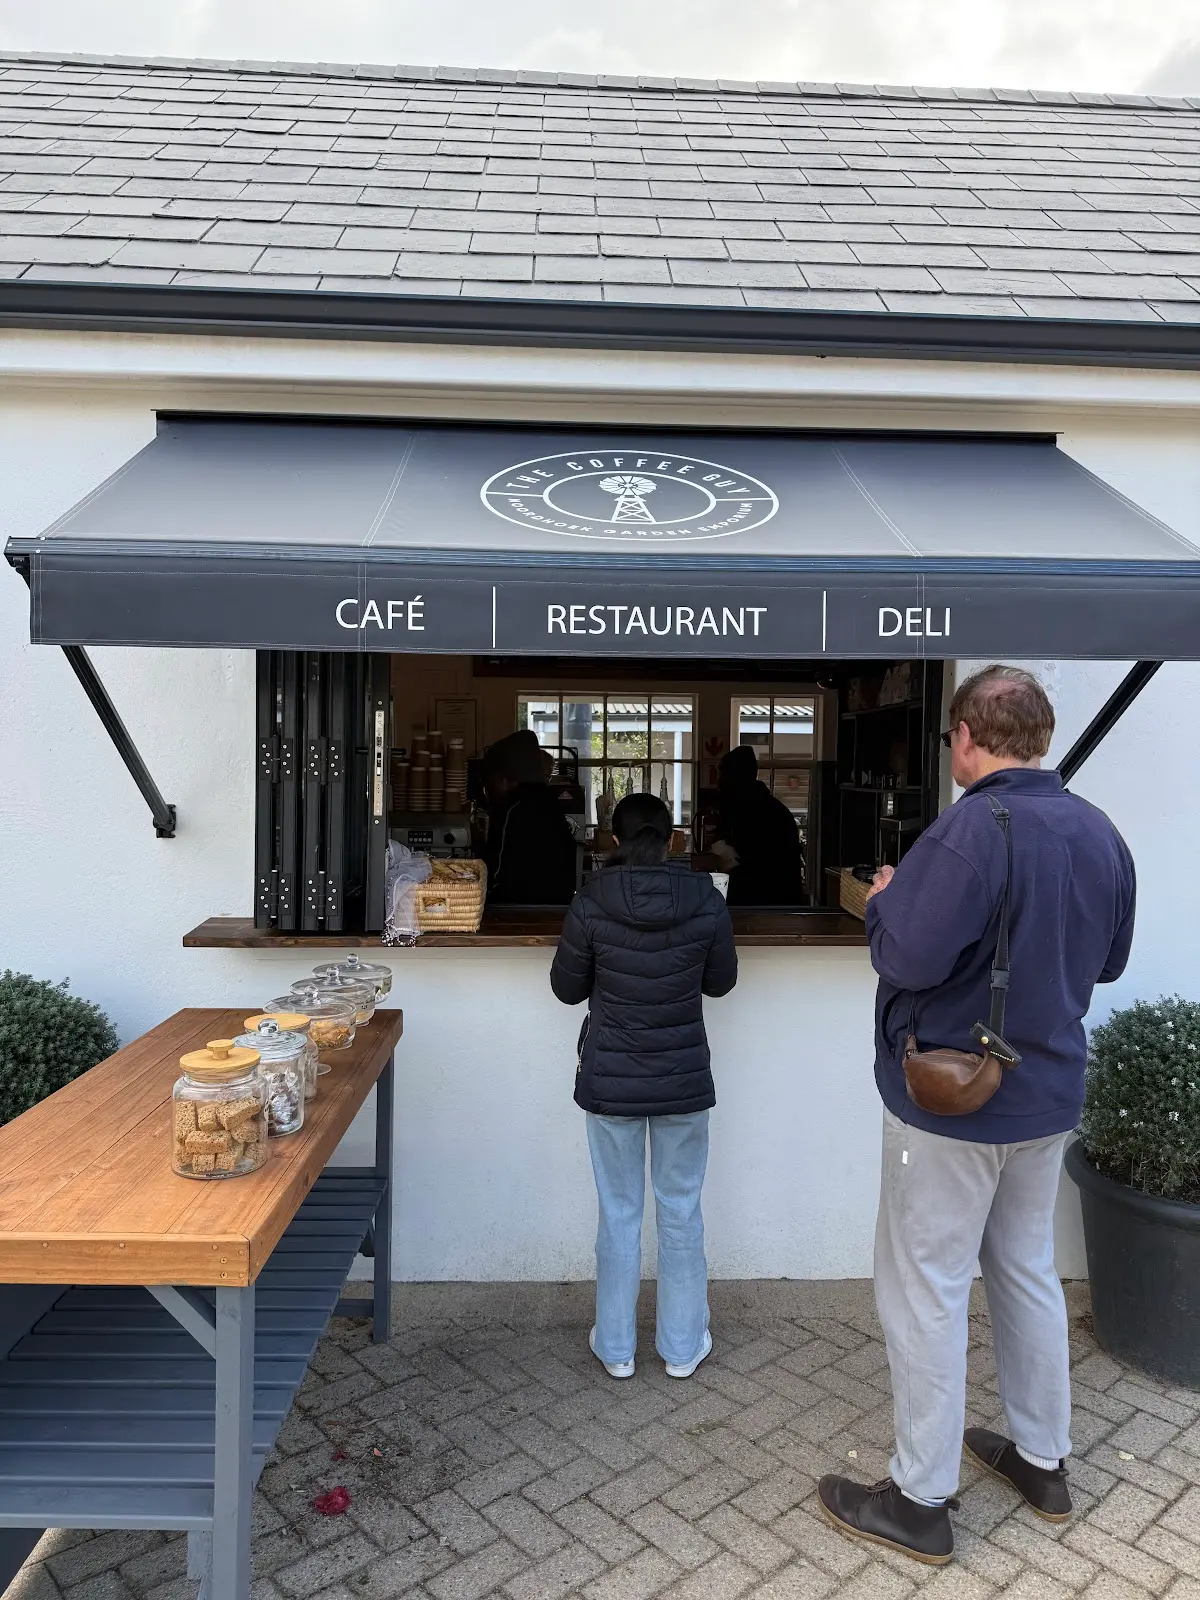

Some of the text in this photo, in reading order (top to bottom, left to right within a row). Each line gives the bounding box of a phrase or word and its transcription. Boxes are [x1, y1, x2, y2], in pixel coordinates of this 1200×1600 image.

[506, 457, 751, 494] THE COFFEE GUY
[508, 498, 593, 532] NOORDHOEK
[697, 502, 753, 532] EMPORIUM
[335, 595, 951, 637] CAFÉ RESTAURANT DELI
